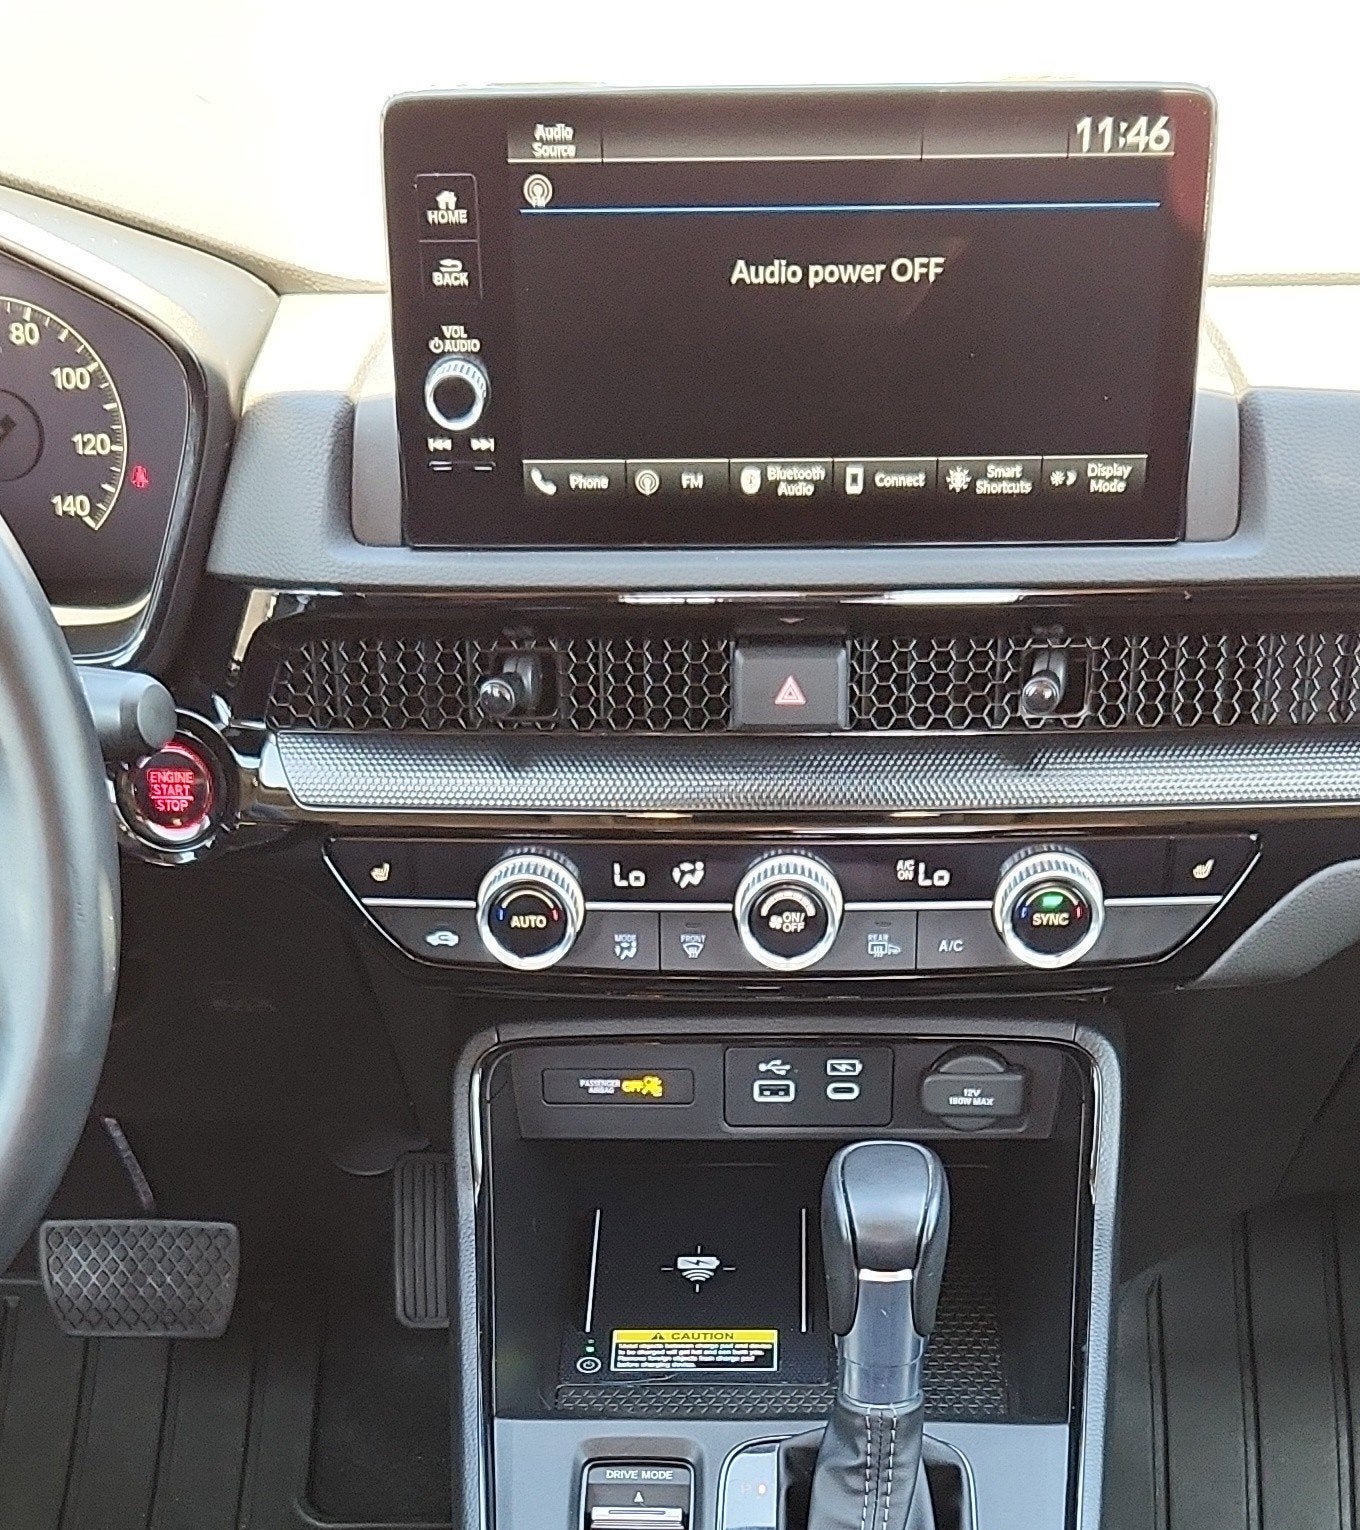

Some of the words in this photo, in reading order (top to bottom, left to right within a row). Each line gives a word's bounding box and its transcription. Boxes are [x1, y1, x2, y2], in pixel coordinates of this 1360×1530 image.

[534, 124, 574, 141] Audio
[1076, 116, 1170, 152] 11:46
[533, 143, 576, 157] Source
[427, 210, 468, 224] HOME
[432, 272, 469, 286] BACK
[730, 259, 802, 284] Audio
[808, 263, 886, 288] power
[891, 257, 945, 283] OFF
[9, 323, 40, 345] 80
[442, 325, 468, 338] VOL
[444, 339, 481, 352] AUDIO
[51, 367, 90, 390] 100
[72, 433, 111, 456] 120
[767, 466, 826, 482] Bluetooth
[987, 464, 1022, 479] Smart
[1087, 463, 1132, 479] Display
[569, 474, 609, 490] Phone
[681, 473, 703, 489] FM
[875, 472, 926, 488] Connect
[976, 479, 1032, 495] Shortcuts
[1090, 479, 1126, 494] Mode
[778, 482, 814, 496] Audio
[51, 495, 90, 517] 140
[150, 771, 194, 783] ENGINE
[153, 784, 191, 796] START
[156, 800, 189, 811] STOP
[897, 870, 914, 880] ON
[510, 915, 547, 929] AUTO
[783, 912, 805, 922] ON/
[1032, 914, 1069, 927] SYNC
[783, 922, 805, 932] OFF
[939, 940, 963, 951] A/C
[671, 1332, 734, 1340] CAUTION
[606, 1470, 638, 1479] DRIVE
[641, 1471, 673, 1479] MODE
